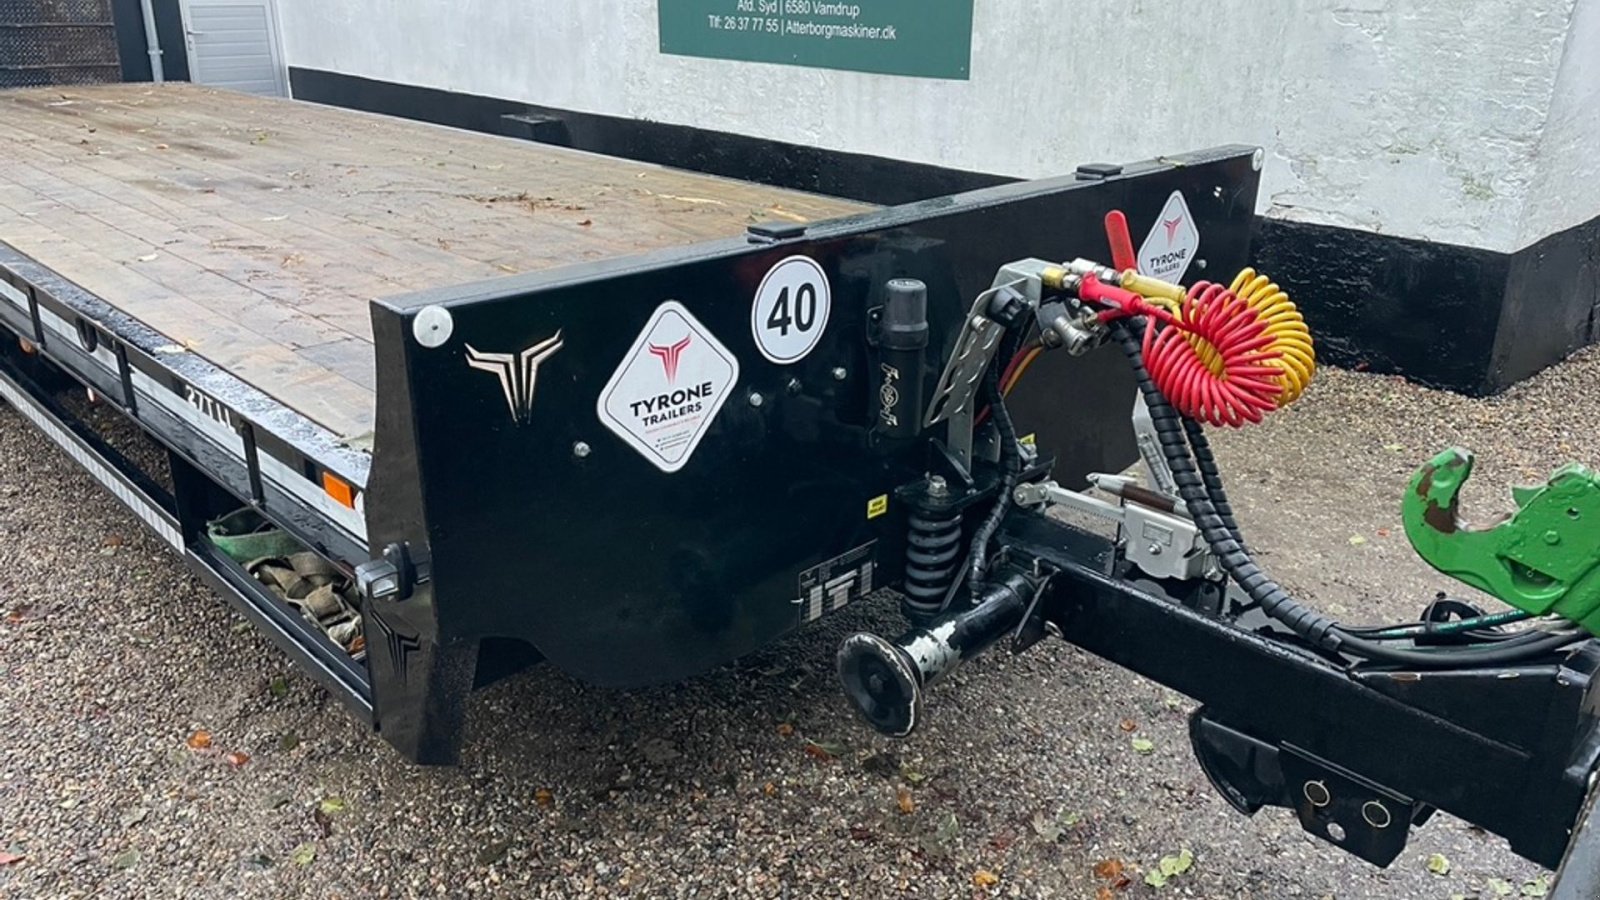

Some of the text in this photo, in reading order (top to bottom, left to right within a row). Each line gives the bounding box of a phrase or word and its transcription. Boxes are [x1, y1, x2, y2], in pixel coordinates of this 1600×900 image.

[759, 0, 777, 15] Syd
[785, 0, 810, 14] 6580
[812, 1, 860, 19] Vamdrup
[724, 16, 737, 30] 26
[737, 17, 750, 31] 37
[752, 17, 764, 31] 77
[766, 18, 779, 33] 55
[785, 19, 897, 40] Atterborgmaskiner.dk
[1150, 248, 1186, 268] TYRONE
[766, 282, 816, 336] 40
[630, 381, 713, 417] TYRONE
[642, 401, 702, 427] TRAILERS
